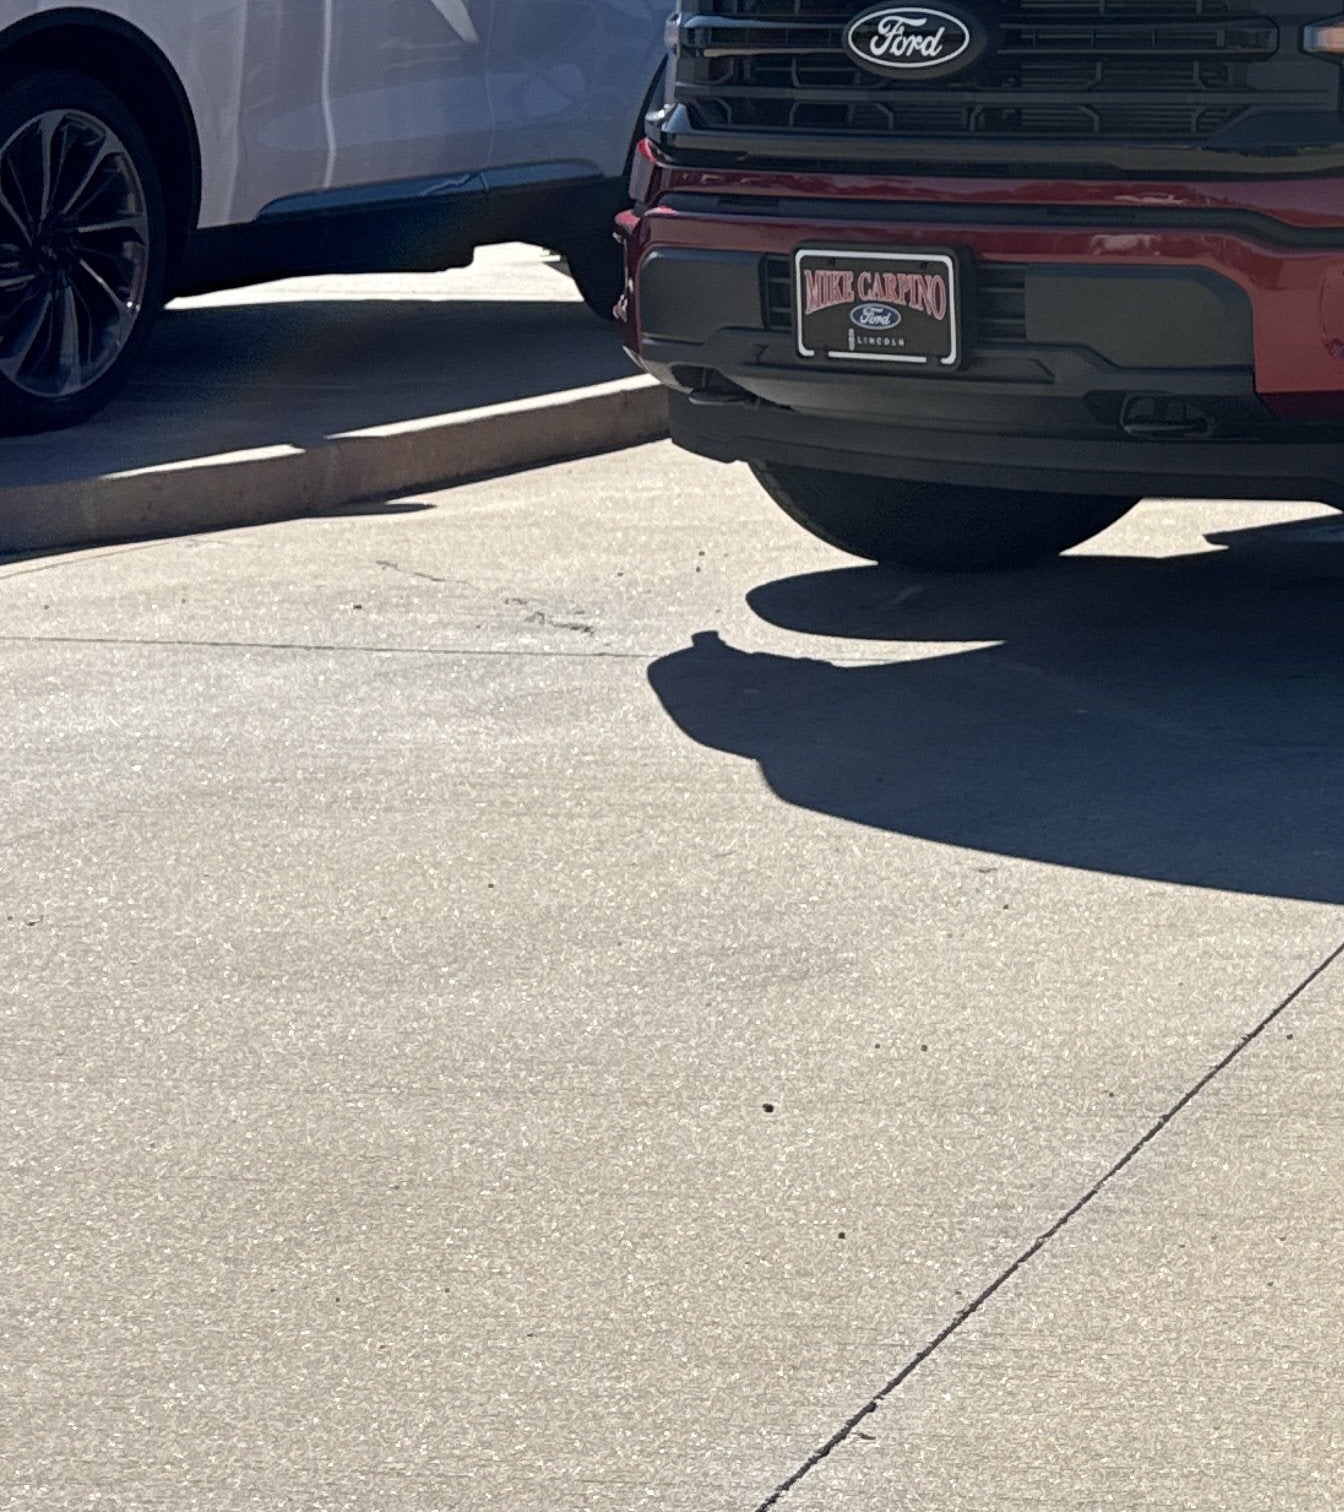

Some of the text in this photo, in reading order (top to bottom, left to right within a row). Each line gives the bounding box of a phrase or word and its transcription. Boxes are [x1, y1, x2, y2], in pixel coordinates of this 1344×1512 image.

[870, 15, 946, 57] Ford
[804, 269, 947, 321] MIKE CARPINO
[859, 307, 892, 324] Ford
[857, 335, 905, 346] LINCOLN
